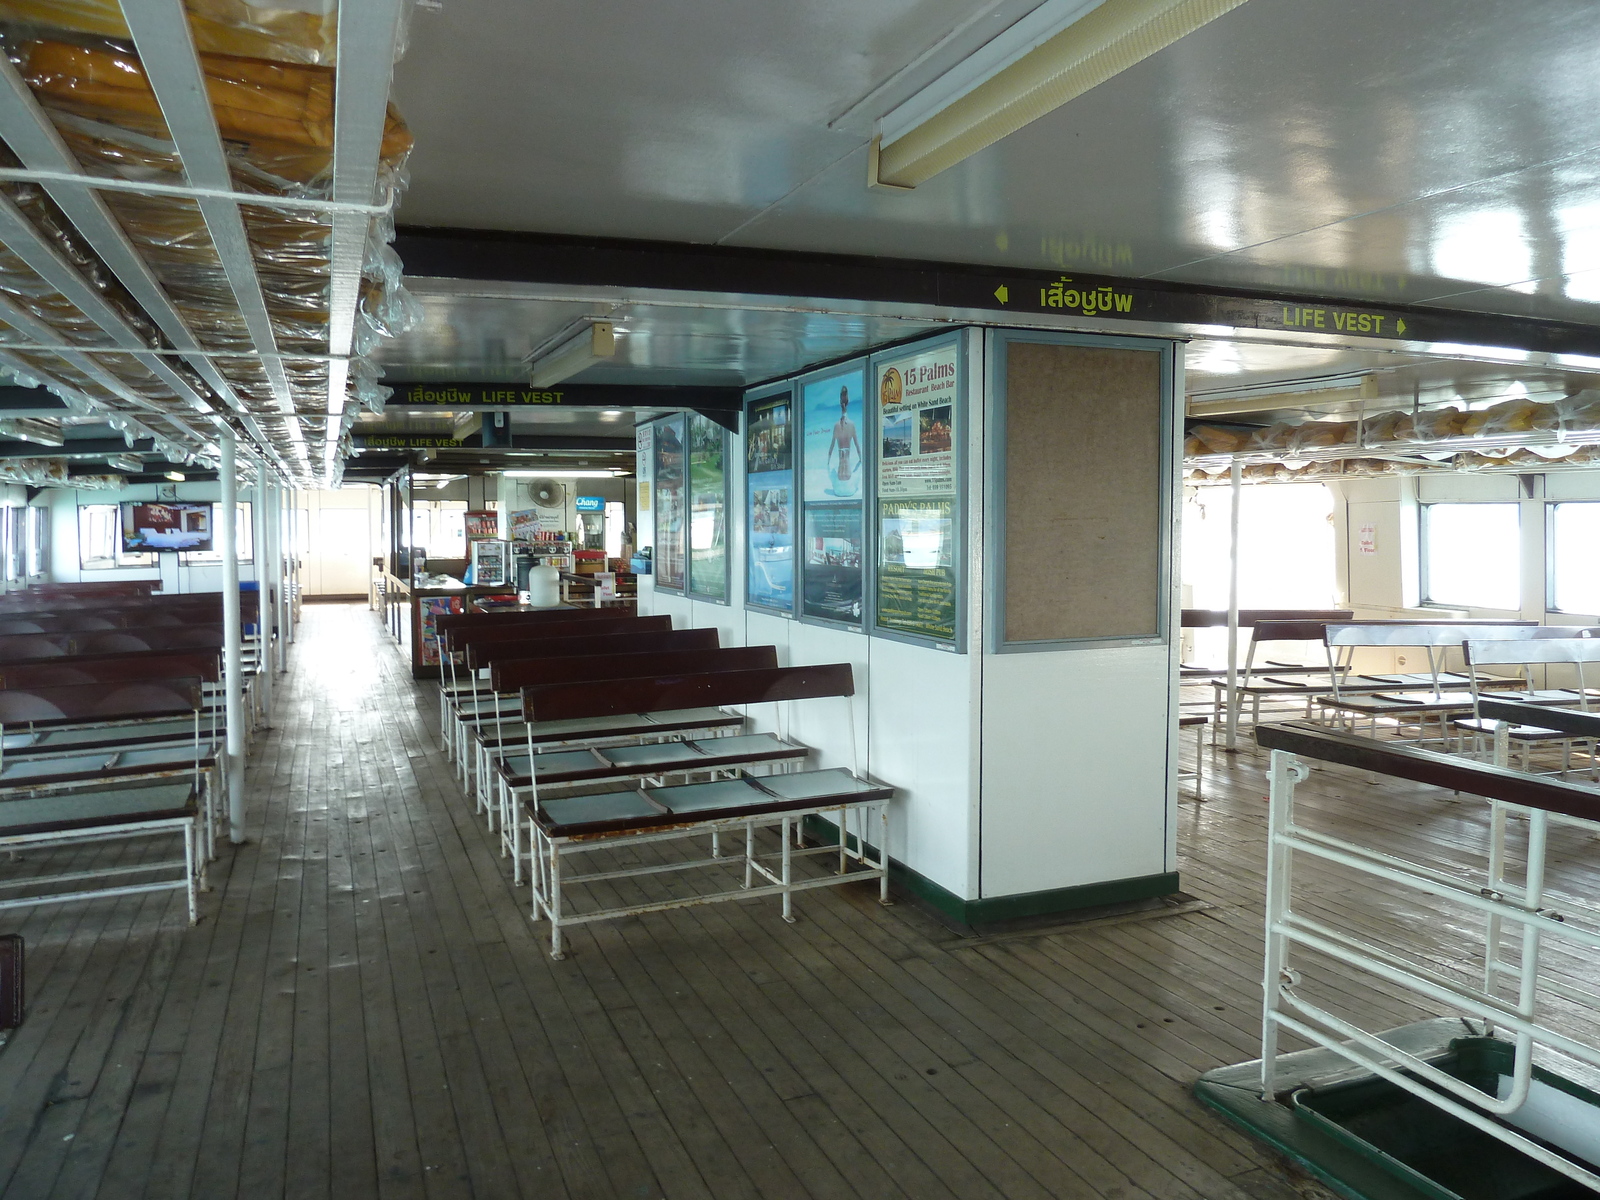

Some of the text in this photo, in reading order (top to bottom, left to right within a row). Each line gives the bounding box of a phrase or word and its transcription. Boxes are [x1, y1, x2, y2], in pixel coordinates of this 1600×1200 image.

[1040, 275, 1133, 316] เสื้อชูชีพ
[1282, 307, 1385, 334] LIFE VEST
[904, 362, 955, 386] 15 Palms
[407, 385, 471, 405] เสื้อชูชีพ
[905, 385, 929, 397] Restaurant
[930, 381, 945, 392] Beach
[945, 380, 955, 388] Bar
[482, 391, 564, 404] LIFE VEST
[917, 399, 928, 408] White
[928, 397, 938, 406] Sand
[939, 395, 952, 404] Beach
[409, 438, 464, 447] LIFE VEST
[576, 497, 599, 508] Chang
